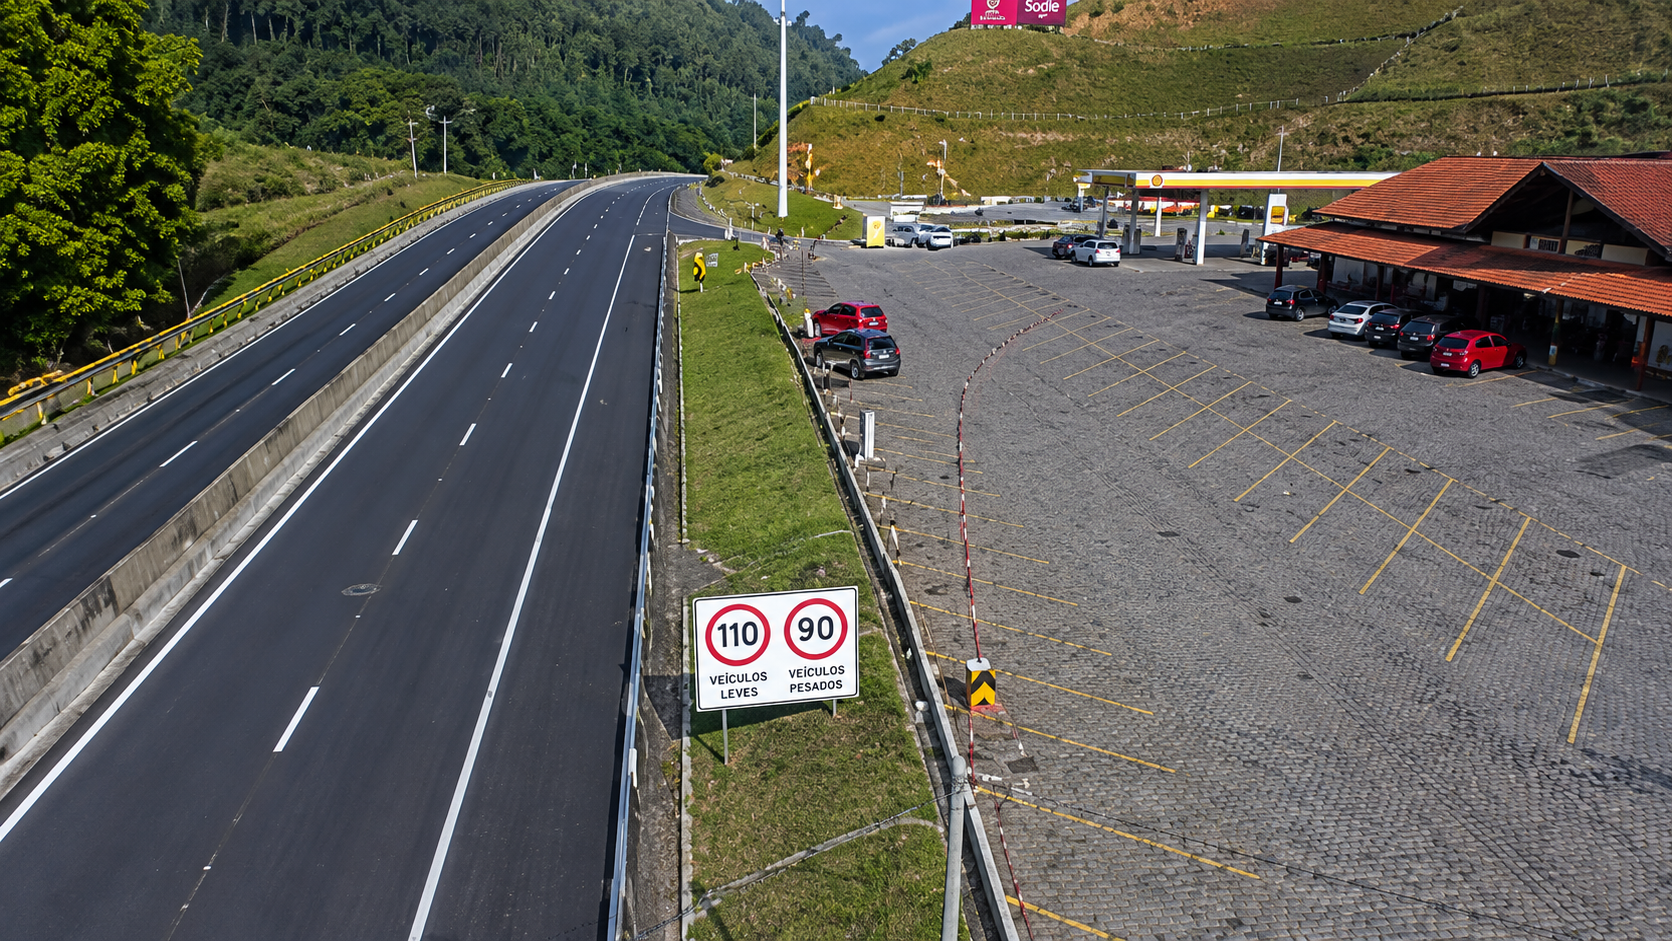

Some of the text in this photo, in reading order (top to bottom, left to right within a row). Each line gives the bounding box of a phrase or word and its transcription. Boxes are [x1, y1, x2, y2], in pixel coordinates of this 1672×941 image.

[718, 621, 758, 647] 110
[798, 615, 834, 641] 90
[709, 671, 768, 685] VEÍCULOS
[788, 665, 845, 679] VEÍCULOS
[720, 687, 758, 700] LEVES
[789, 680, 843, 693] PESADOS
